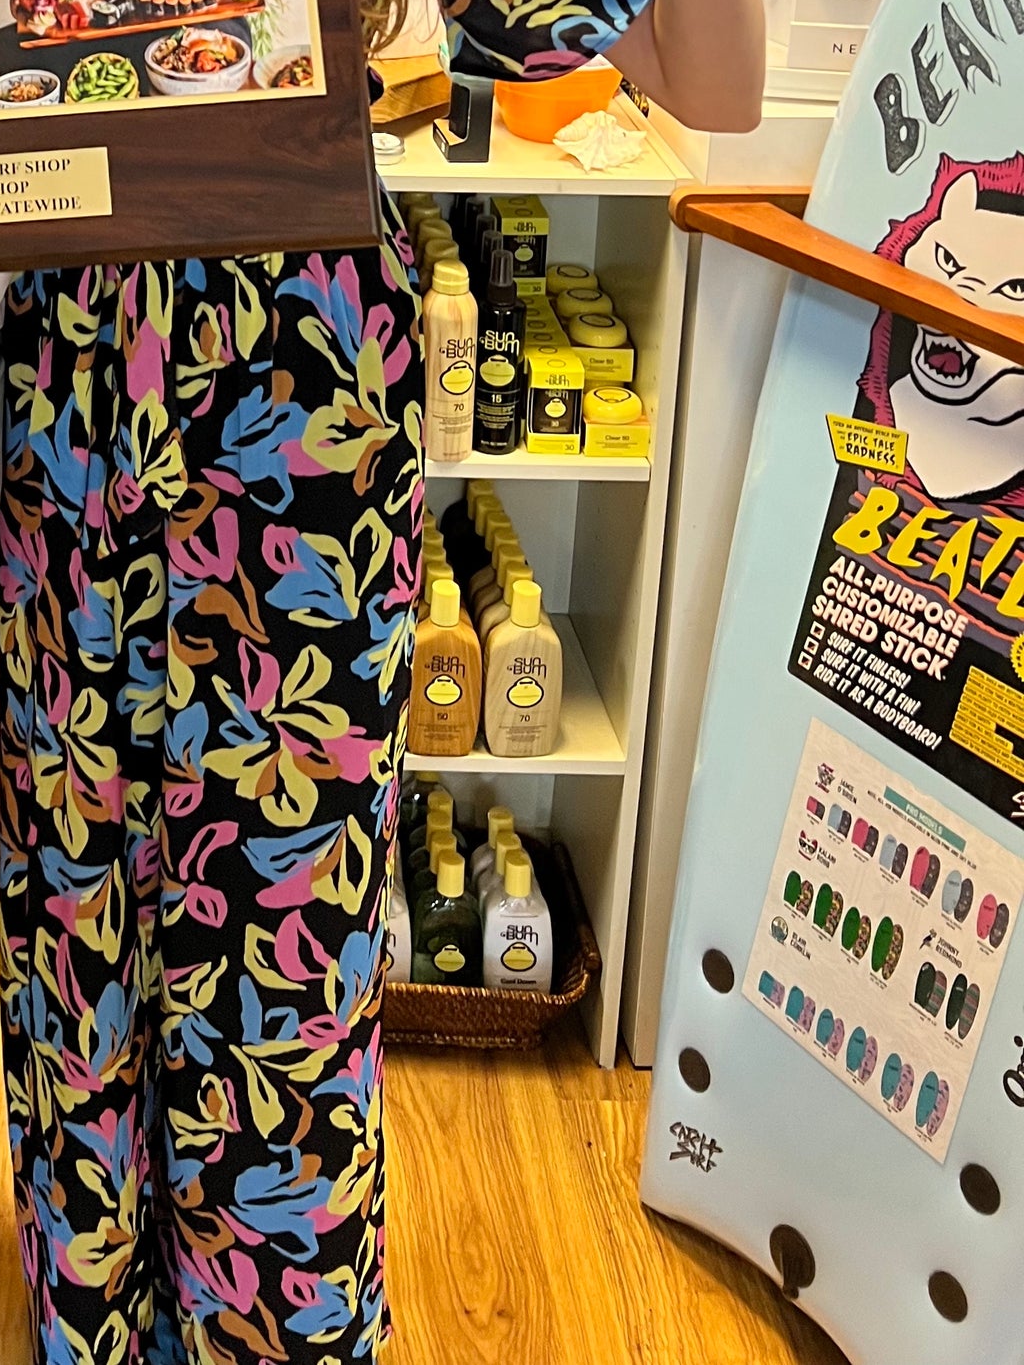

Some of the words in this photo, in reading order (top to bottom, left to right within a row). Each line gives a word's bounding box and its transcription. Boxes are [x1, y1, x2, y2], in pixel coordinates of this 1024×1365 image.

[25, 157, 71, 174] SHOP
[453, 403, 465, 412] 70
[564, 443, 575, 451] 30
[845, 442, 896, 466] RADNESS
[847, 431, 869, 446] EPIC
[873, 437, 895, 452] TALE
[828, 555, 969, 639] ALL-PURPOSE
[811, 594, 878, 644] SHRED
[822, 575, 960, 659] CUSTOMIZABLE
[827, 631, 854, 656] SURF
[852, 644, 868, 662] IT
[864, 651, 912, 690] FINLESS!
[820, 647, 847, 672] SURF
[845, 661, 861, 679] IT
[857, 671, 888, 696] WITH
[883, 687, 897, 703] A
[894, 692, 922, 717] FIN!
[519, 714, 531, 723] 70
[813, 663, 840, 688] RIDE
[836, 677, 852, 694] IT
[848, 685, 866, 705] AS
[862, 693, 876, 710] A
[872, 700, 943, 751] BODYBOARD!
